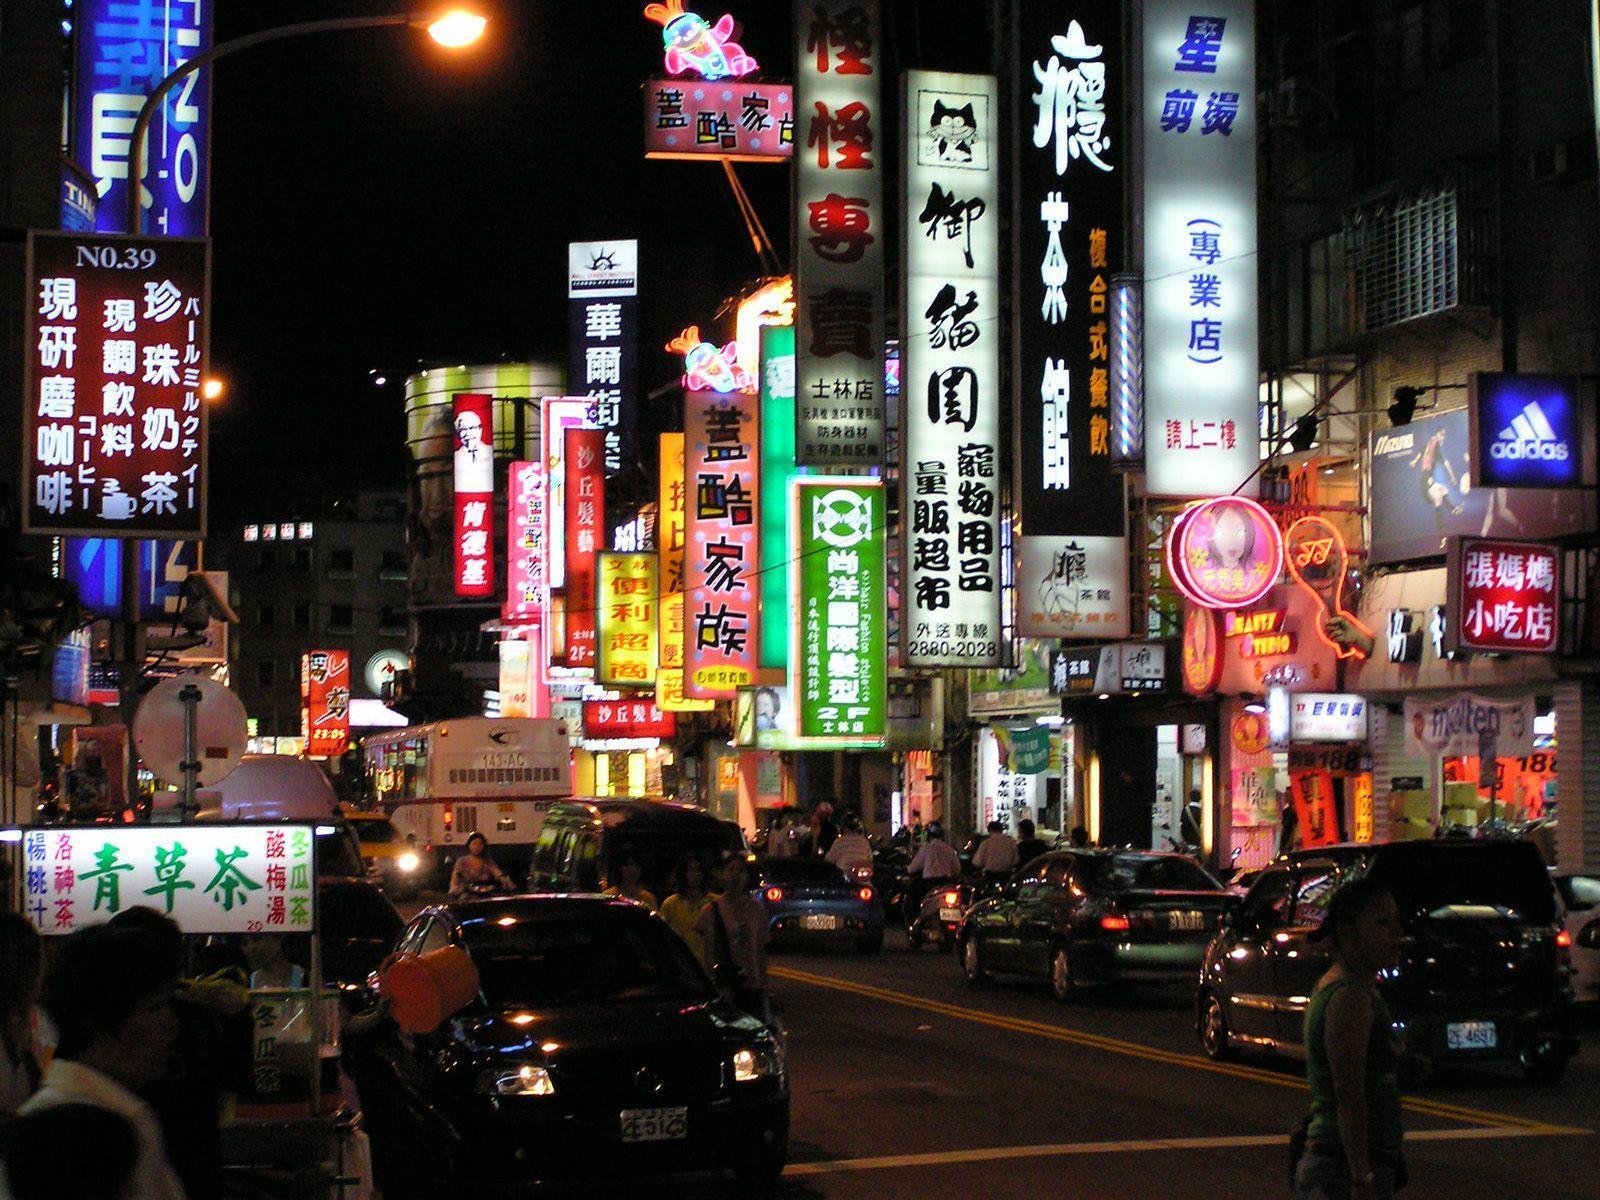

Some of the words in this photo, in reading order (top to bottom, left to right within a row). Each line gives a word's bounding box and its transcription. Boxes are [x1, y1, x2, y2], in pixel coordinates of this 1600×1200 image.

[1160, 88, 1240, 137] 剪燙
[37, 277, 78, 516] 現研磨咖啡
[101, 299, 137, 457] 現調飲料
[141, 279, 182, 516] 珍珠奶茶
[812, 378, 874, 400] 士林店
[78, 415, 97, 510] コーヒー
[1166, 419, 1237, 450] 請上二樓
[1490, 439, 1568, 461] adidas
[913, 461, 951, 611] 量販超市
[957, 443, 995, 593] 寵物用品
[1465, 551, 1555, 592] 張媽媽
[609, 576, 650, 680] 便利超商
[1465, 599, 1553, 641] 小吃店
[54, 832, 75, 928] 洛神茶
[77, 842, 263, 914] 青草茶
[266, 830, 287, 925] 酸梅湯
[290, 831, 310, 925] 冬瓜茶
